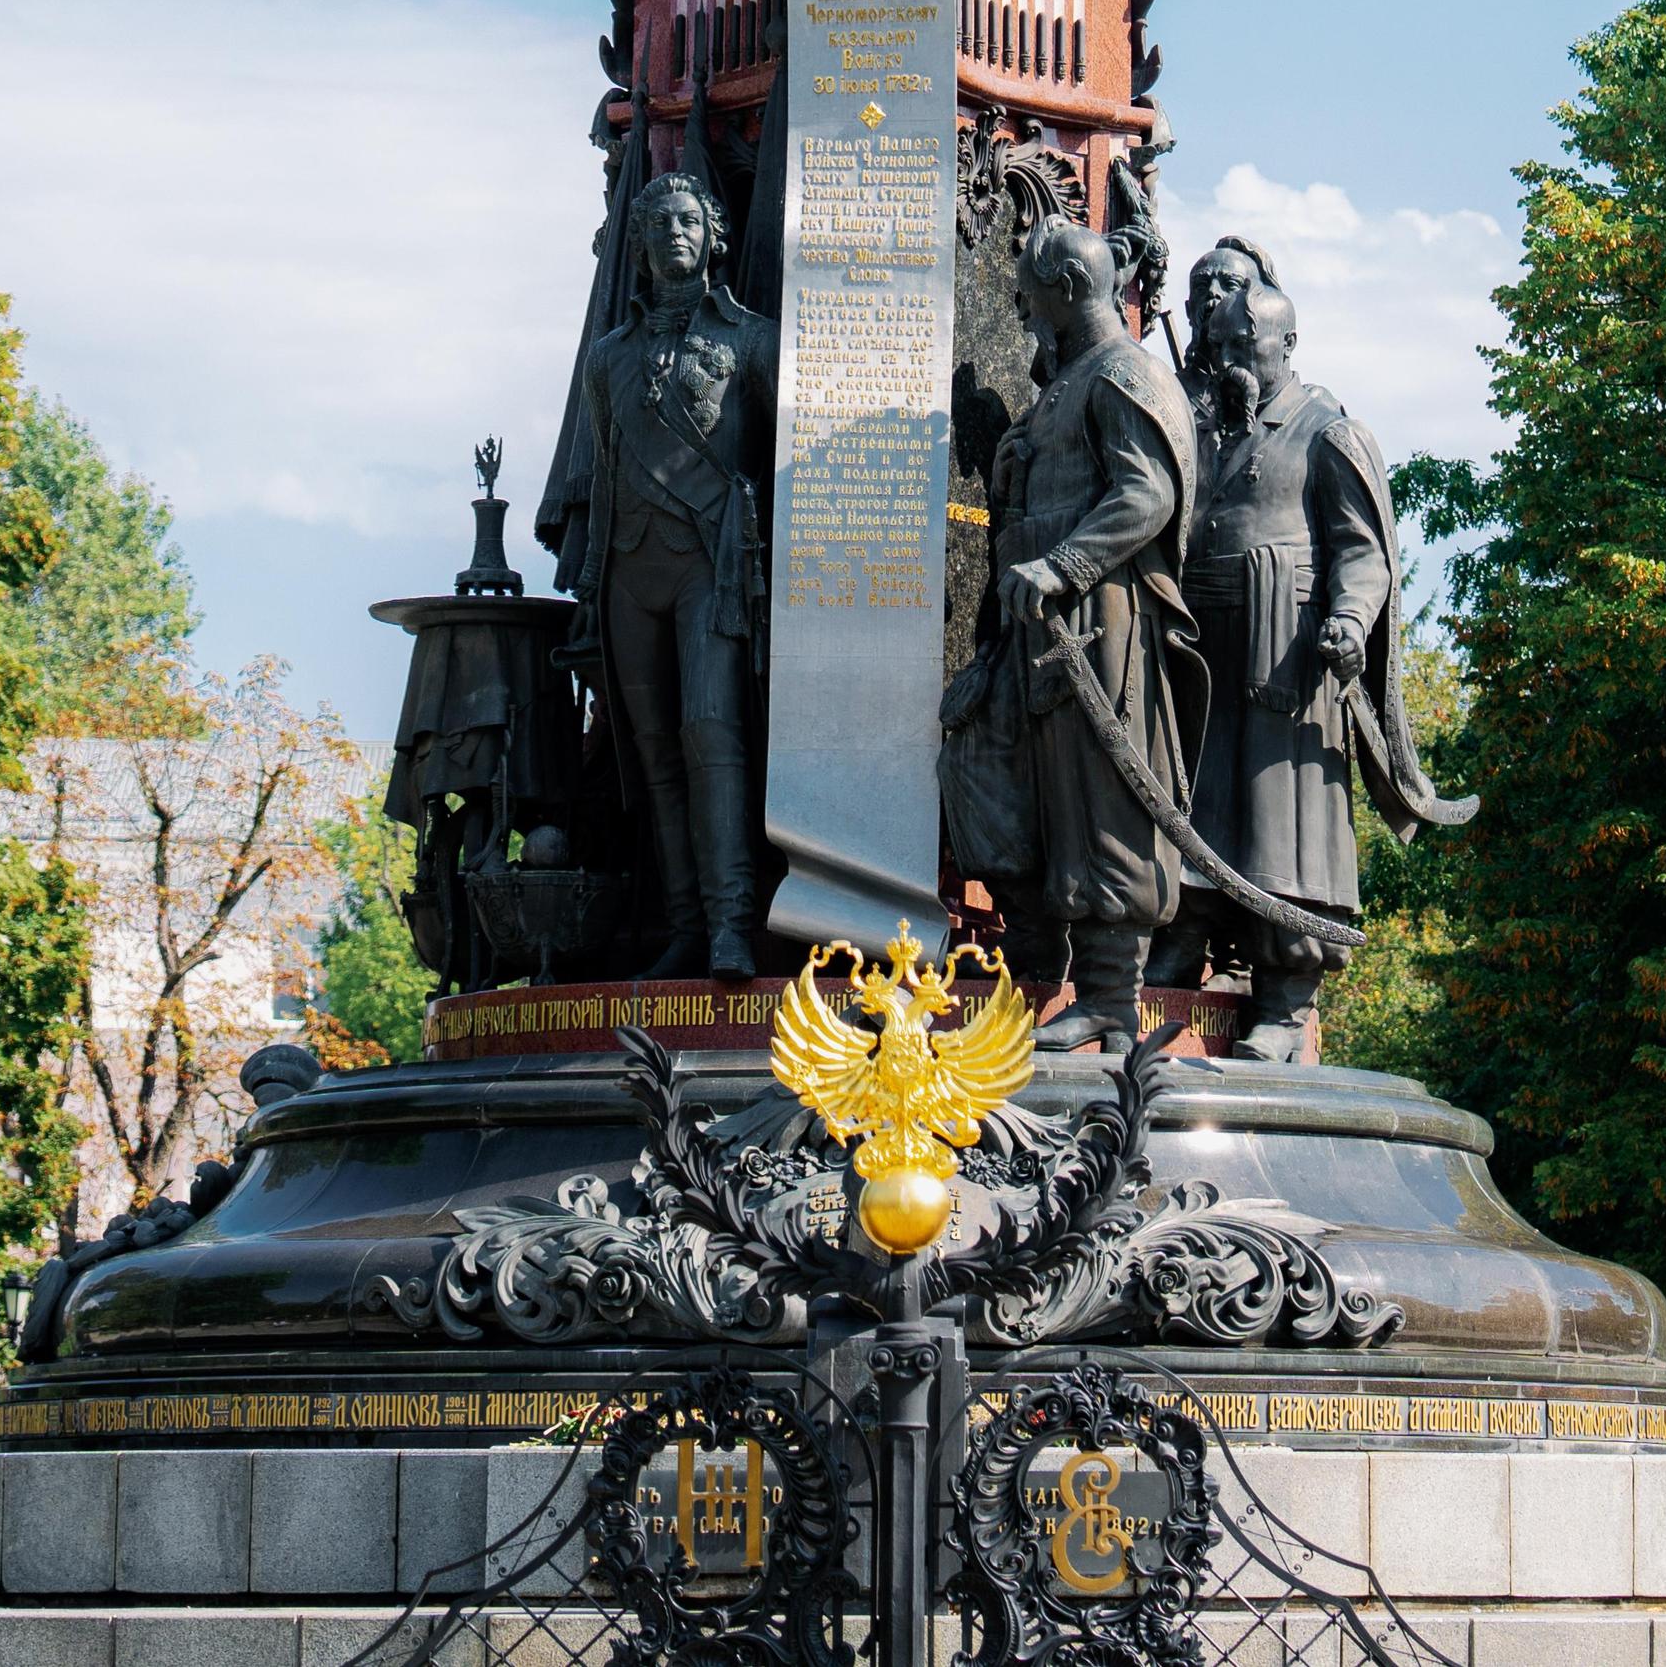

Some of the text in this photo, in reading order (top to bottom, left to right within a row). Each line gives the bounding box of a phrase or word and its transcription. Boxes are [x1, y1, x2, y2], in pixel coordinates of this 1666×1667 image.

[806, 3, 938, 24] Черноморскому
[828, 30, 916, 46] казачьему
[842, 48, 902, 71] Войску
[813, 76, 835, 94] 30
[884, 74, 920, 93] 1792
[880, 135, 939, 151] Нашего
[804, 152, 940, 168] Войска Черномор-
[804, 170, 939, 184] скаго Кошевому
[858, 204, 901, 216] всему
[801, 217, 825, 230] ску
[833, 216, 886, 231] Нашего
[801, 249, 849, 264] чества
[877, 306, 935, 322] Войска
[797, 318, 934, 337] Черноморскаго
[824, 389, 891, 405] Портою
[796, 406, 884, 420] томанскою
[794, 435, 931, 451] мужественными
[843, 468, 931, 482] подвигами,
[792, 498, 833, 511] ность,
[835, 498, 888, 510] строгое
[847, 511, 928, 526] Начальству
[804, 529, 883, 542] похвальное
[818, 562, 851, 574] того
[541, 993, 604, 1031] ГРИГОРІЙ
[313, 1397, 332, 1409] 1892
[445, 1396, 466, 1408] 1904
[247, 1395, 310, 1428] МАЛАМА
[351, 1394, 441, 1429] ОДИНЦОВЪ
[1269, 1394, 1403, 1432] САМОДЕРЖЦЕВЪ
[1409, 1398, 1483, 1433] АТАМАНЫ
[312, 1415, 331, 1426] 1904
[637, 1487, 661, 1504] ТЪ
[1111, 1516, 1149, 1535] 892
